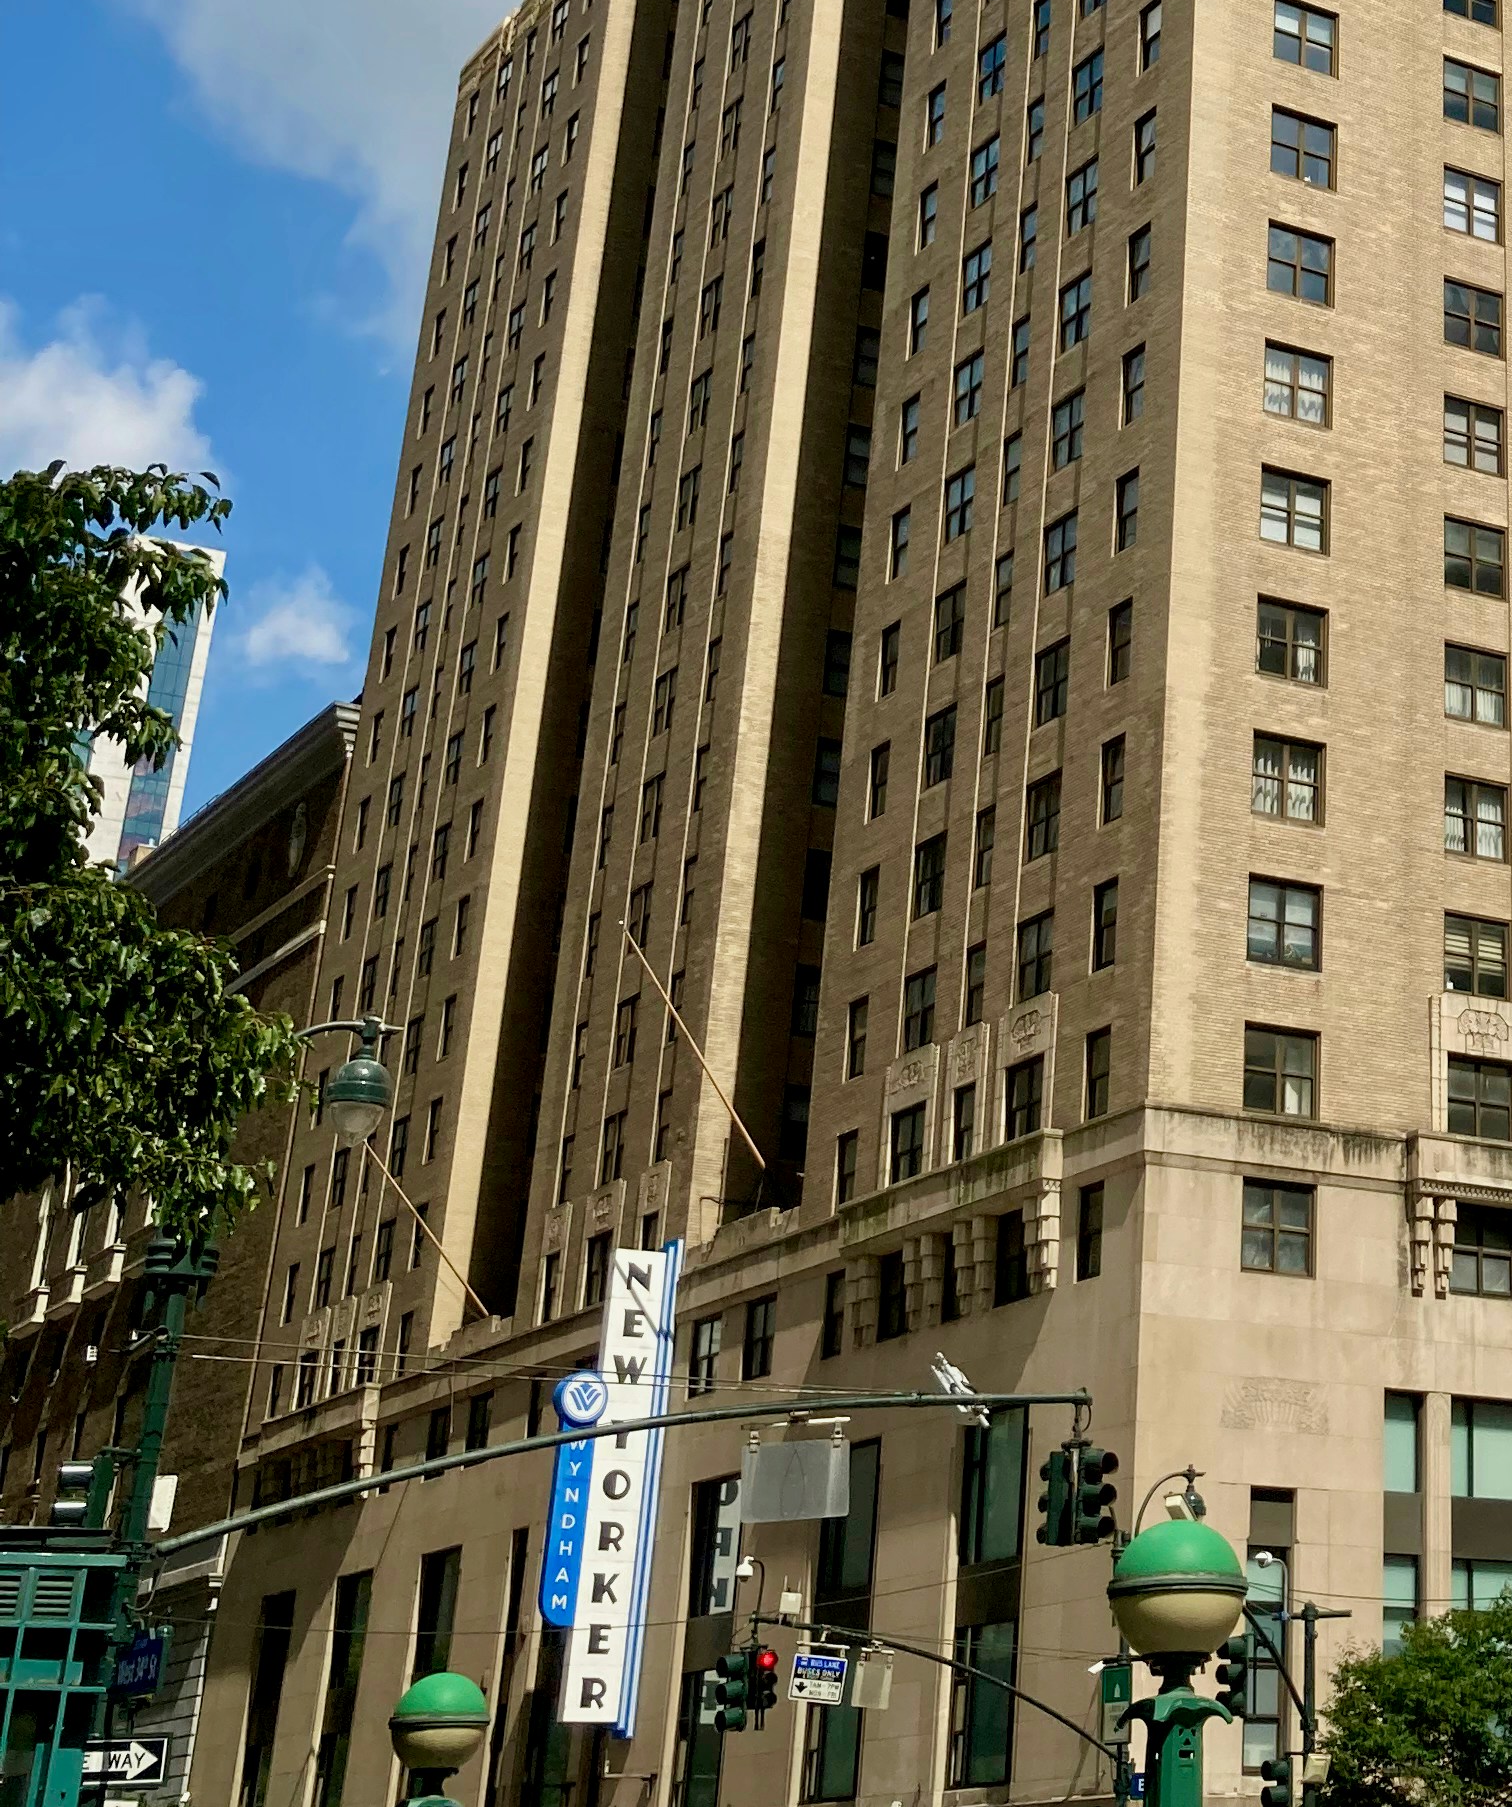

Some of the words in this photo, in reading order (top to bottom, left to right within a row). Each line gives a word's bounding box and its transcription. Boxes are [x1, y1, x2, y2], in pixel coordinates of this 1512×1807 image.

[613, 1261, 653, 1385] NEW
[551, 1438, 587, 1610] WYNDHAM
[108, 1753, 146, 1769] WAY
